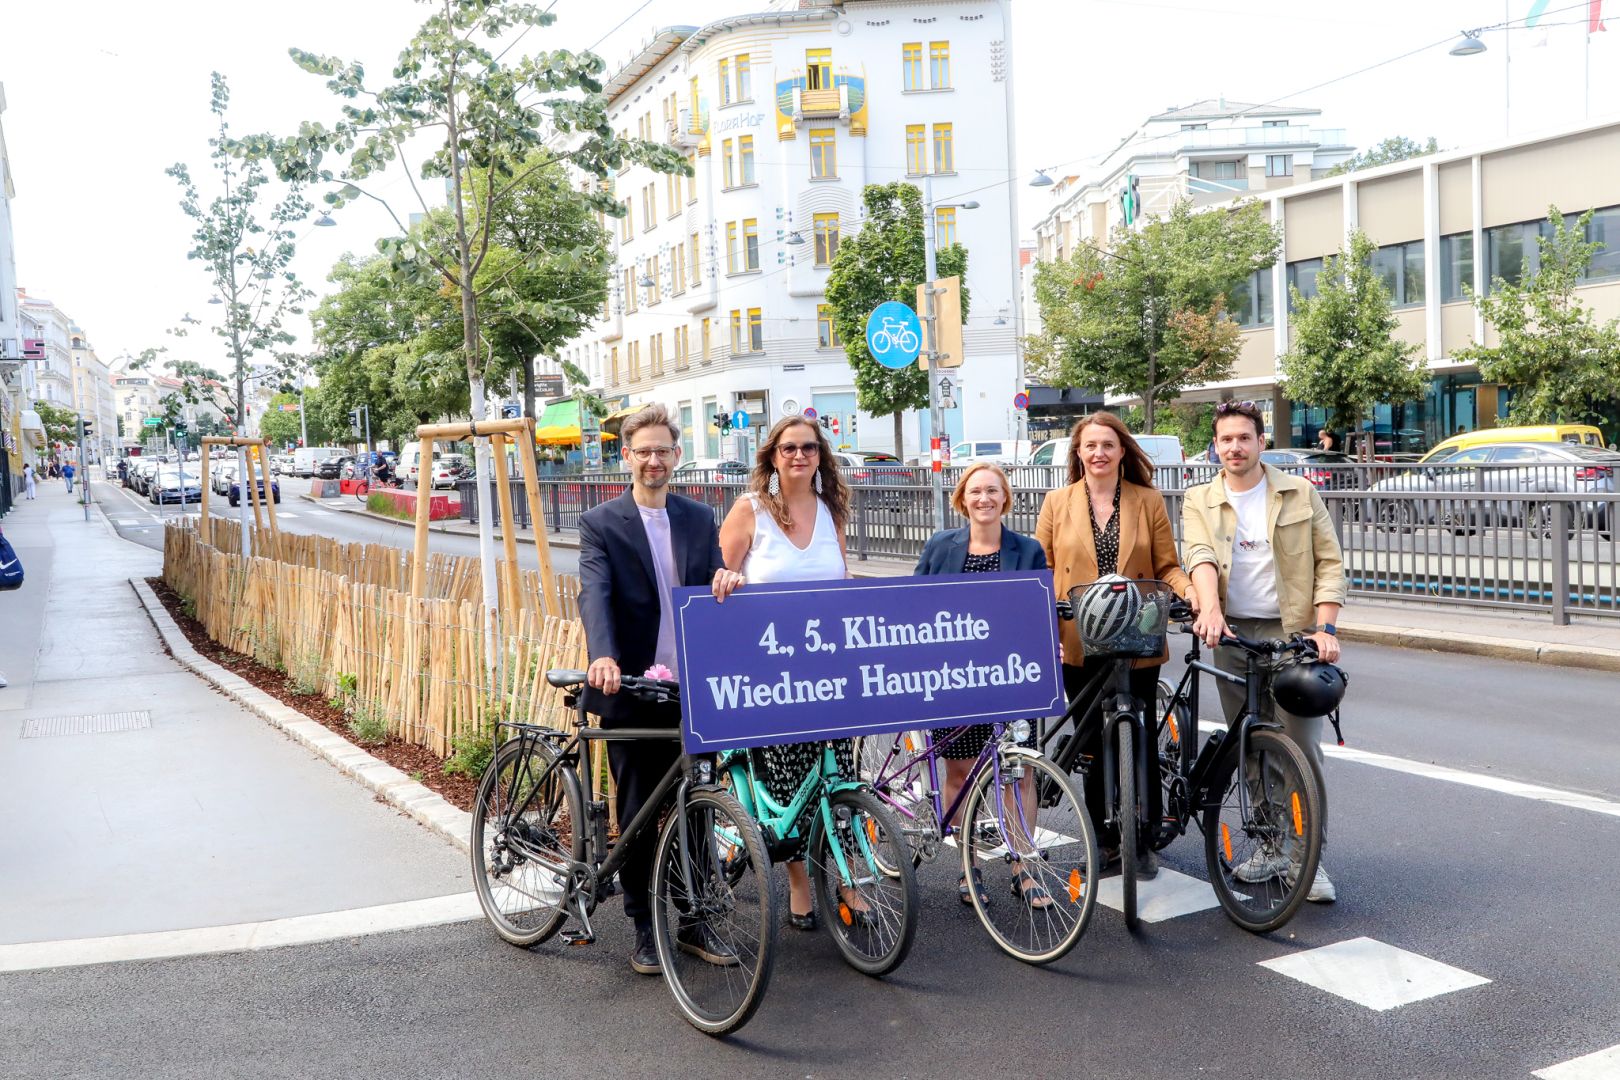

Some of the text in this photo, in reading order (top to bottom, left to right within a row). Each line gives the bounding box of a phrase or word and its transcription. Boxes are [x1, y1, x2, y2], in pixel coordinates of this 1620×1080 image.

[758, 610, 990, 657] 4., 5., Klimafitte
[705, 652, 1042, 711] Wiedner Hauptstraße
